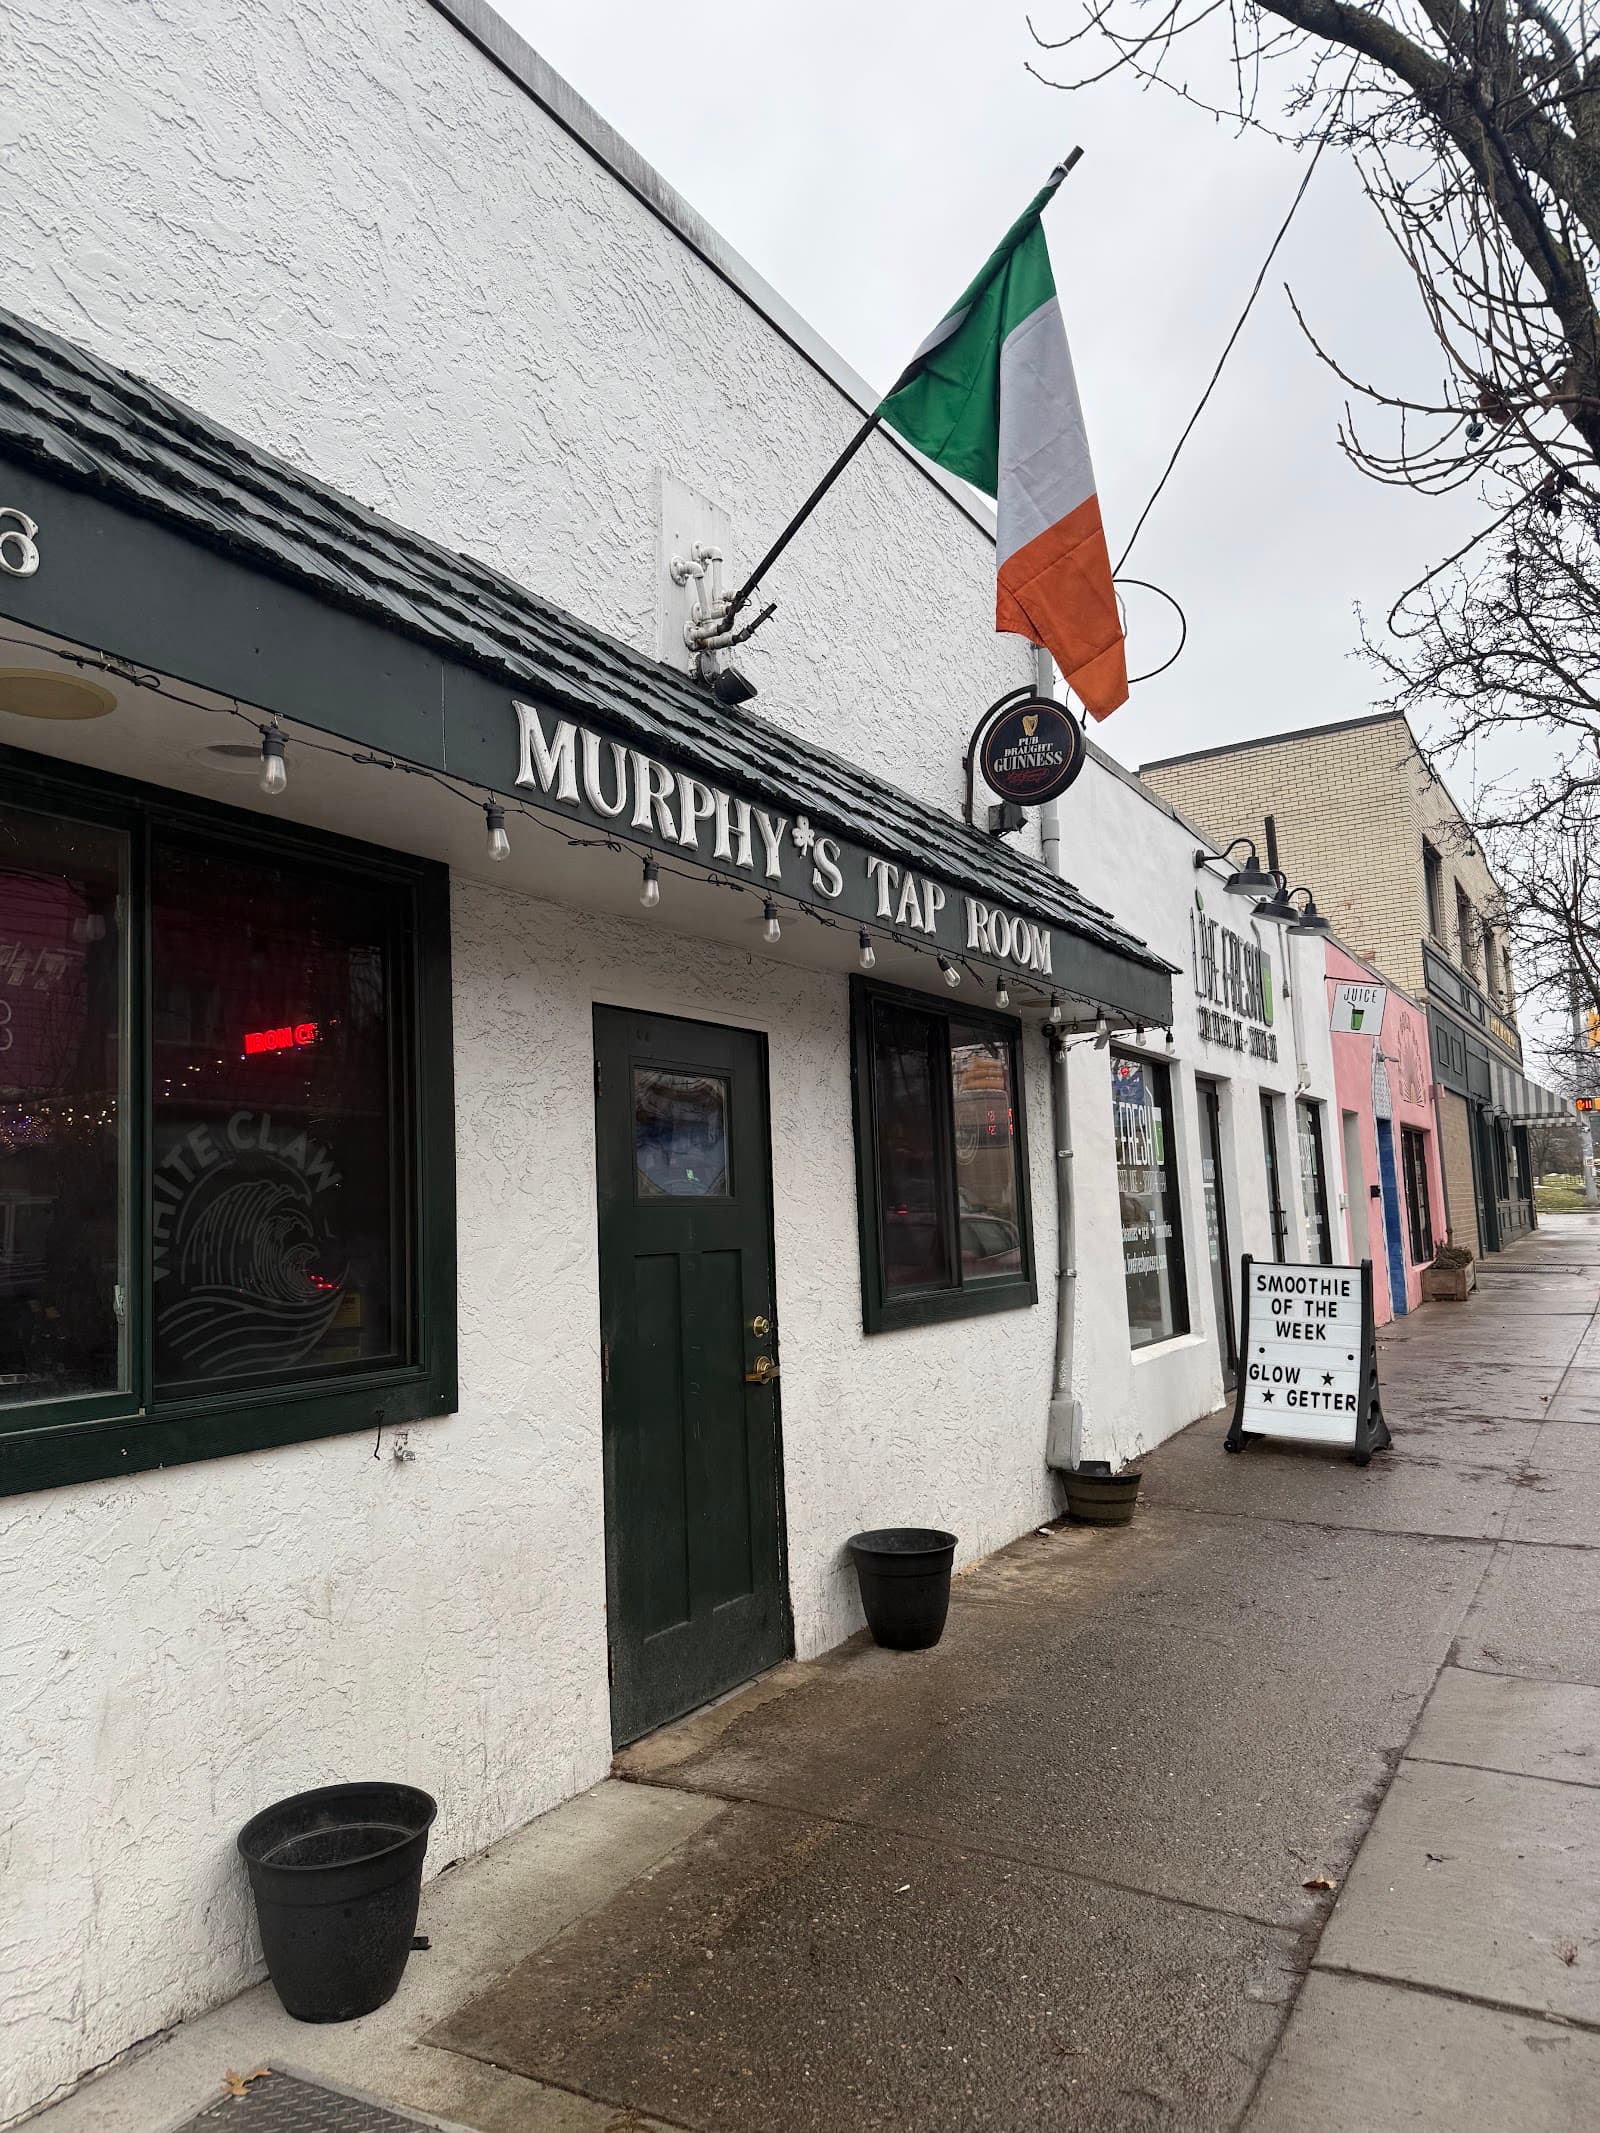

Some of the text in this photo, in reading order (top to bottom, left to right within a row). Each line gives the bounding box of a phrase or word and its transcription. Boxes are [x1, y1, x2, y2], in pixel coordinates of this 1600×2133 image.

[1004, 743, 1053, 757] DRAUGHT
[1018, 736, 1039, 747] PUB
[993, 751, 1063, 773] GUINNESS
[866, 855, 946, 935] TAP
[965, 896, 1053, 976] ROOM
[1343, 987, 1378, 1004] JUICE
[1119, 1101, 1155, 1165] FRESH
[227, 1110, 343, 1193] CLAW
[1257, 1275, 1350, 1297] SMOOTHIE
[1271, 1298, 1338, 1318] OF THE
[1276, 1321, 1326, 1340] WEEK
[1249, 1364, 1300, 1384] GLOW
[1287, 1389, 1356, 1411] GETTER
